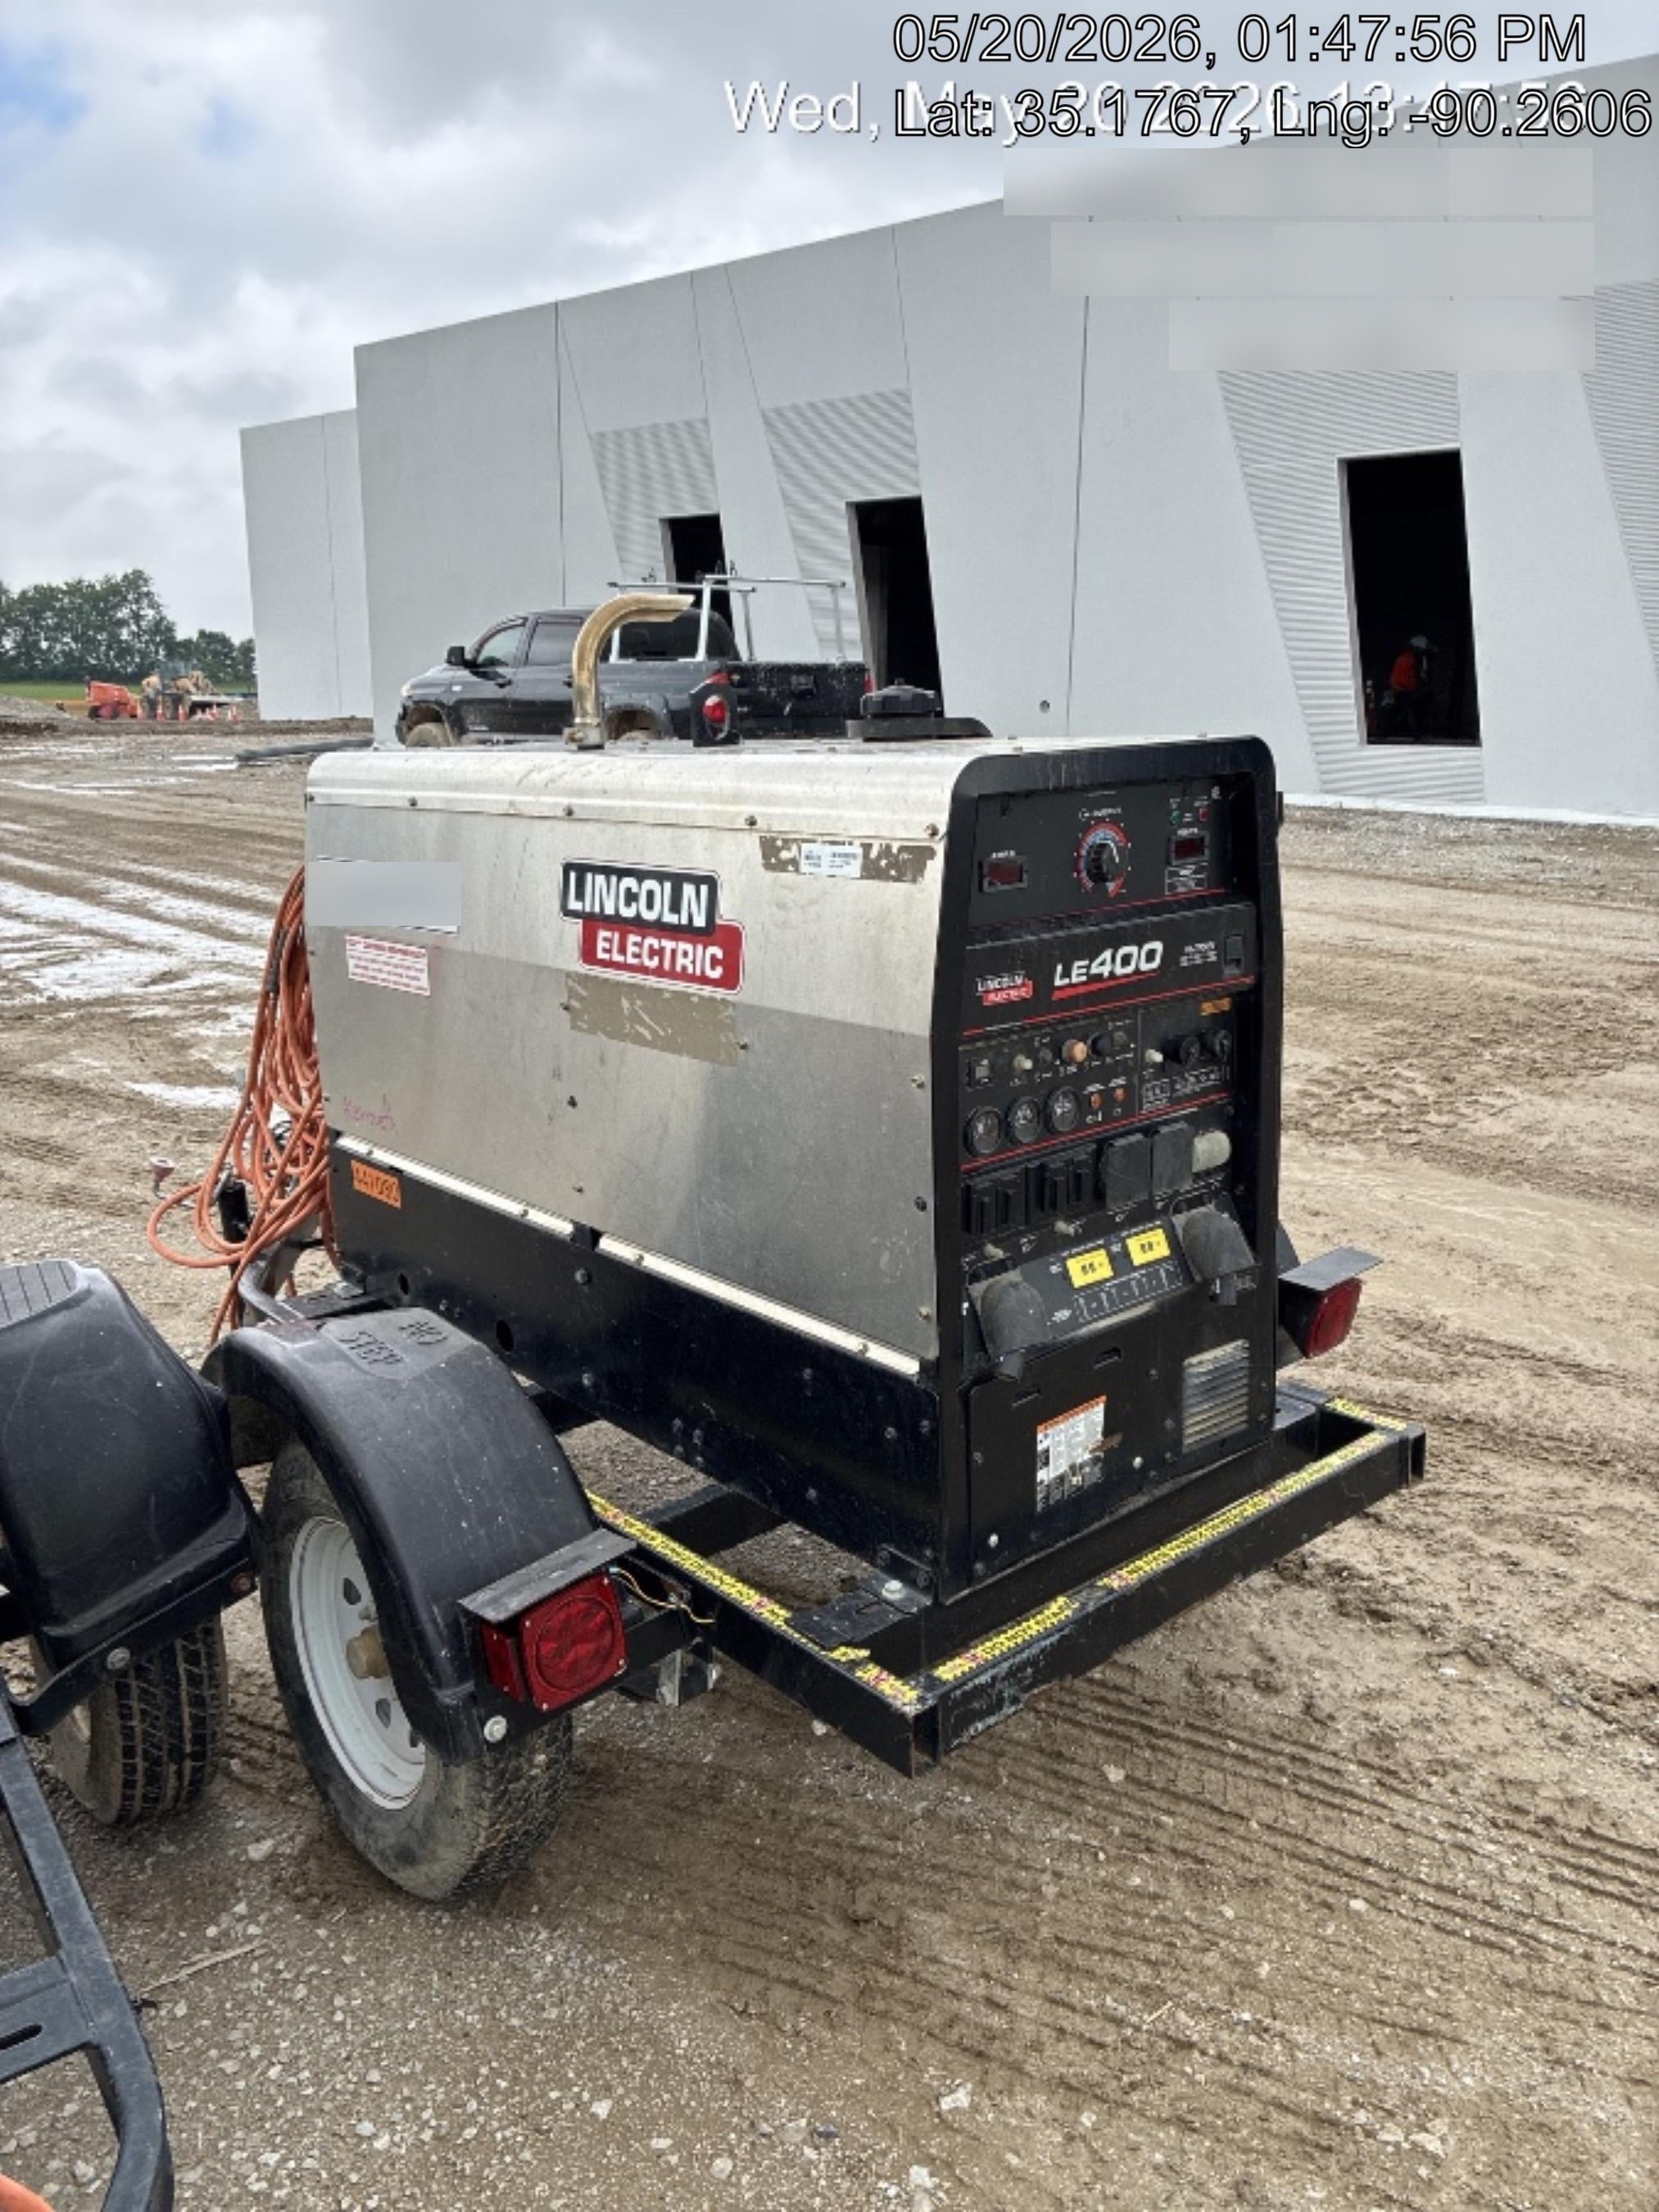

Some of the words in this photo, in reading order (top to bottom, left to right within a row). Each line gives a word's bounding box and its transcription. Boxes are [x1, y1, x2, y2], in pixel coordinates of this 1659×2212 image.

[567, 870, 709, 928] LINCOLN
[596, 928, 724, 980] ELECTRIC
[1054, 941, 1164, 986] LE400
